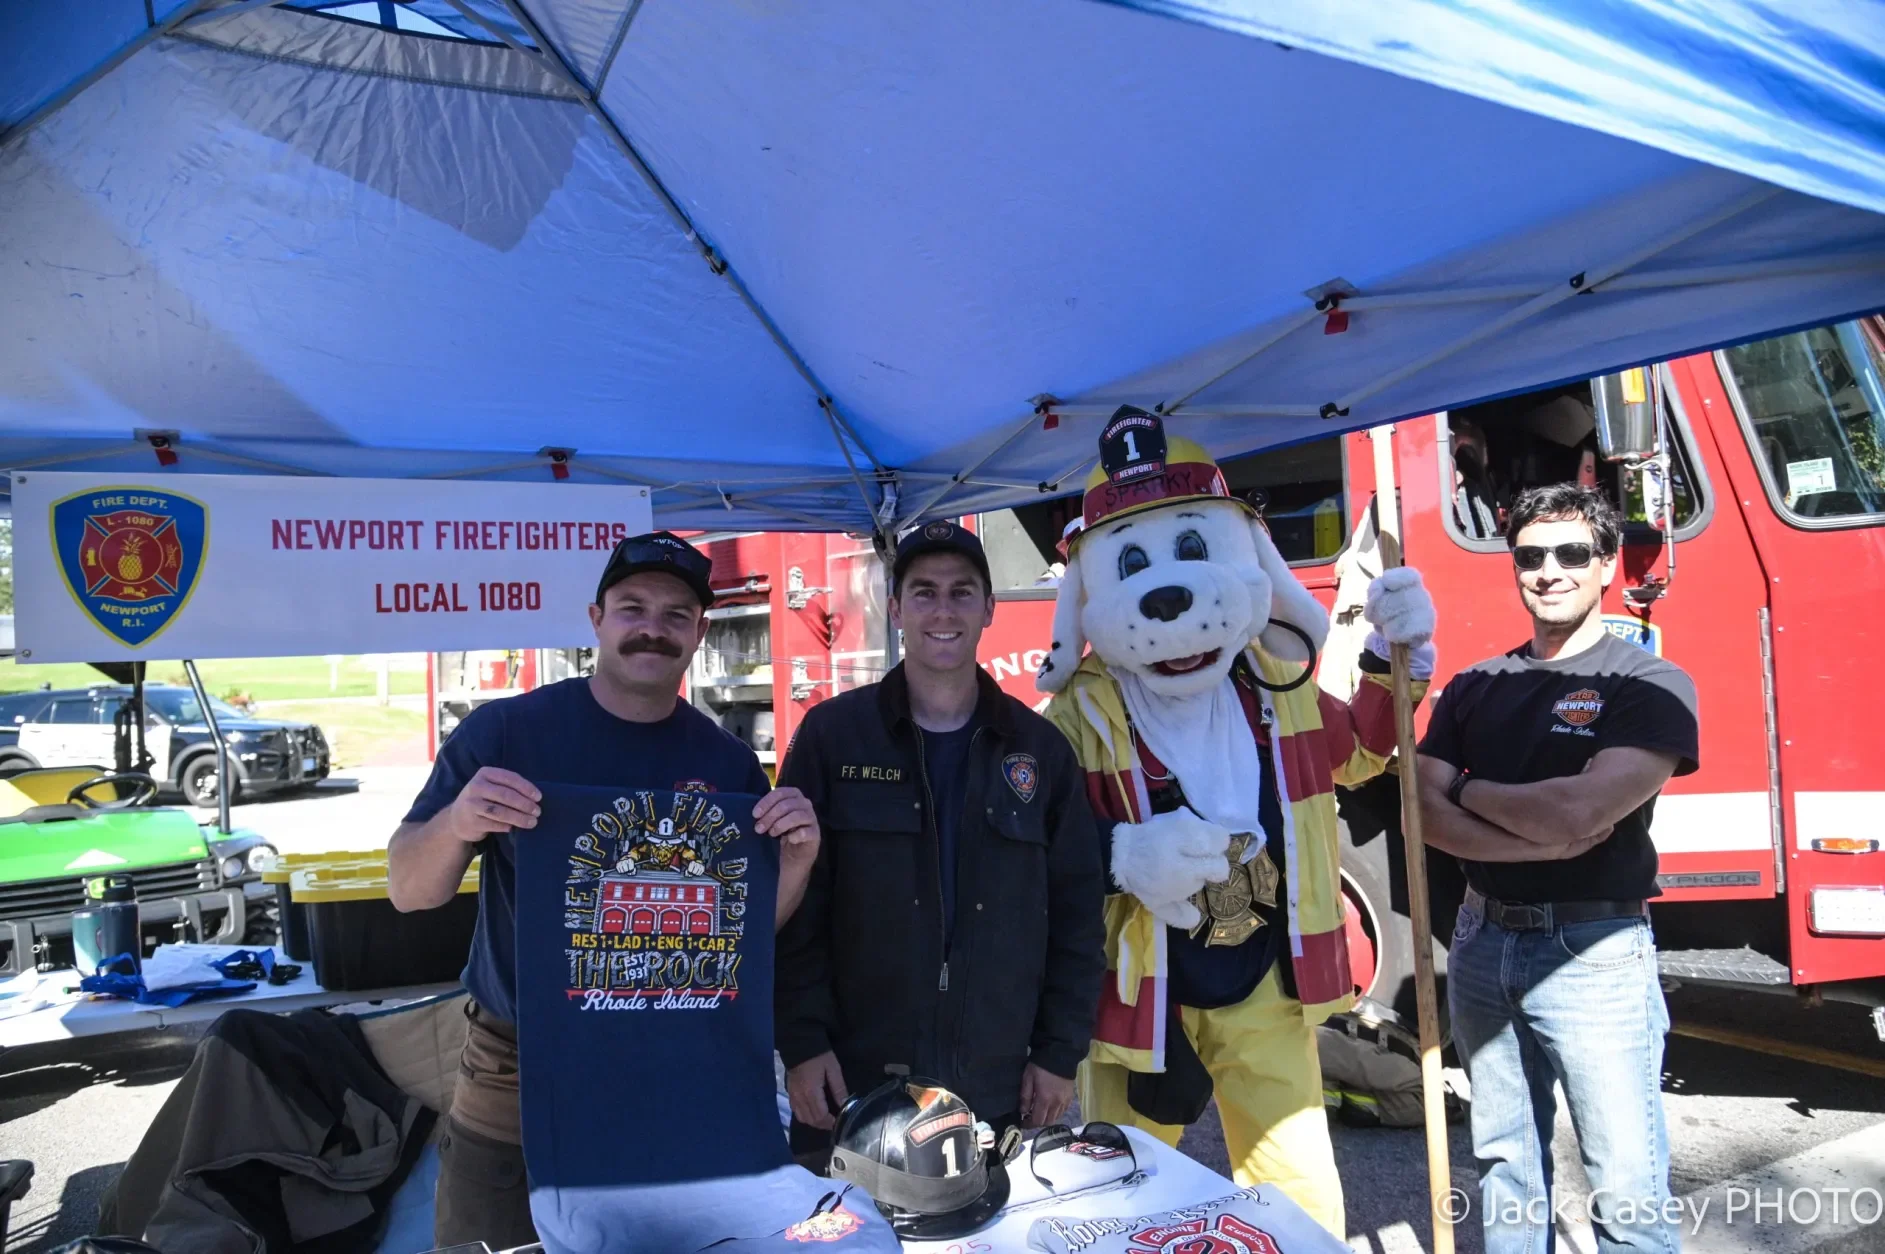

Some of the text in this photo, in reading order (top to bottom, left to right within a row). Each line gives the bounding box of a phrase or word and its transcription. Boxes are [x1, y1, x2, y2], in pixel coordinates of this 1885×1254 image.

[1106, 416, 1153, 439] FIREFIGHTER
[1123, 430, 1141, 462] 1
[1119, 463, 1154, 479] NEWPORT
[1105, 471, 1193, 507] SPARKY
[92, 495, 168, 509] FIRE DEPT.
[126, 515, 155, 526] 1080
[271, 518, 627, 551] NEWPORT FIREFIGHTERS
[375, 582, 541, 613] LOCAL 1080
[100, 602, 166, 616] NEWPORT
[122, 618, 145, 627] R.I.
[980, 649, 1048, 682] NG
[1556, 701, 1603, 713] NEWPORT
[841, 765, 901, 781] FF. WELCH
[564, 791, 655, 929] NEWPORT
[671, 792, 741, 853] FIRE
[1662, 874, 1758, 885] YPHOON
[572, 933, 598, 948] RES
[613, 935, 642, 949] LAD
[657, 936, 684, 950] ENG
[698, 937, 726, 951] CAR
[727, 938, 736, 951] 2
[565, 949, 742, 990] THE ROCK
[624, 967, 648, 981] 1931
[580, 987, 721, 1011] Rhode Island
[941, 1137, 961, 1178] 1
[1149, 1224, 1196, 1243] ENGINE
